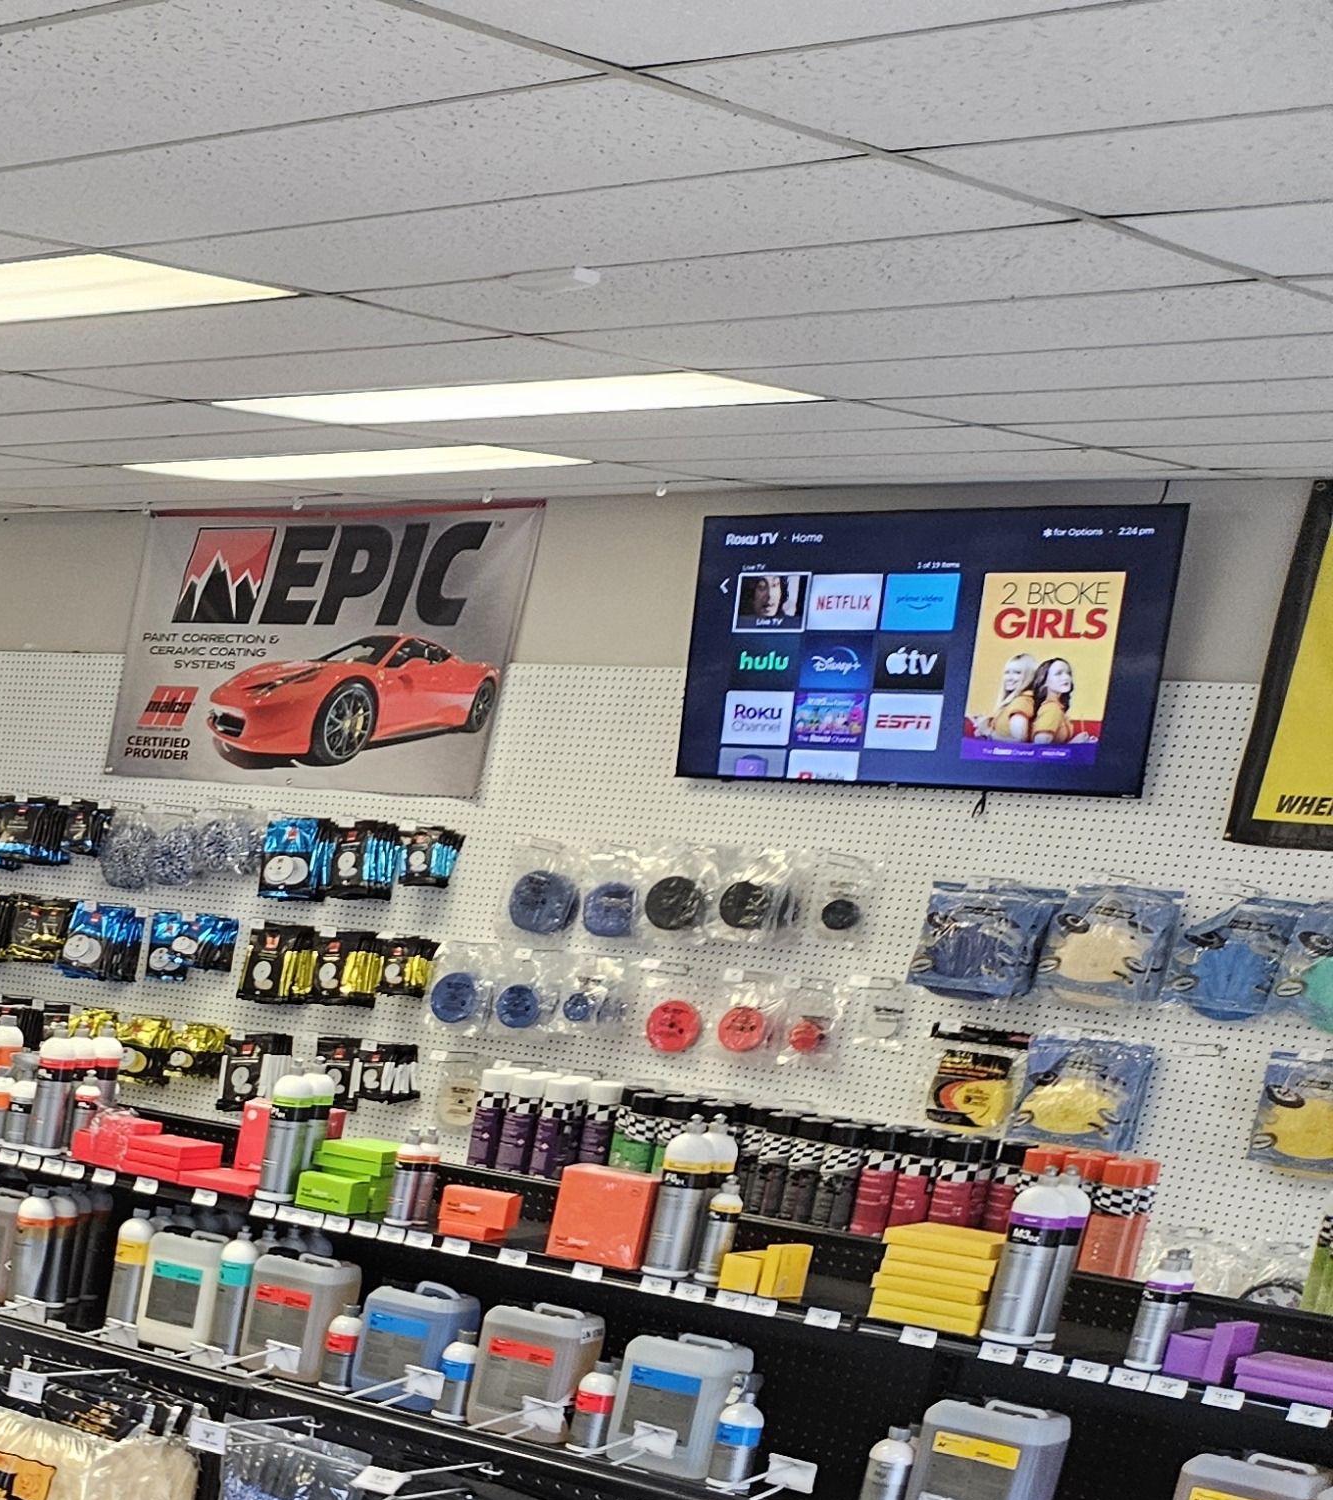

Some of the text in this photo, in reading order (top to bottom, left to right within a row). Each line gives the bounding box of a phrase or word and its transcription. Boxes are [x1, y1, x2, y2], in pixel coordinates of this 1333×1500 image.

[725, 532, 779, 546] Roku TV
[791, 532, 824, 544] Home
[1068, 527, 1104, 538] Options
[258, 520, 493, 627] EPIC
[1000, 581, 1111, 605] 2 BROKE
[816, 594, 872, 611] NETFLIX
[993, 607, 1109, 640] GIRLS
[142, 633, 178, 642] PAINT
[182, 633, 266, 644] CORRECTION
[149, 646, 267, 658] CERAMIC COATING
[174, 659, 236, 670] SYSTEMS
[739, 650, 790, 672] hulu
[734, 703, 784, 720] Roku
[875, 714, 933, 730] ESPN
[127, 735, 191, 748] CERTIFIED
[124, 747, 189, 760] PROVIDER
